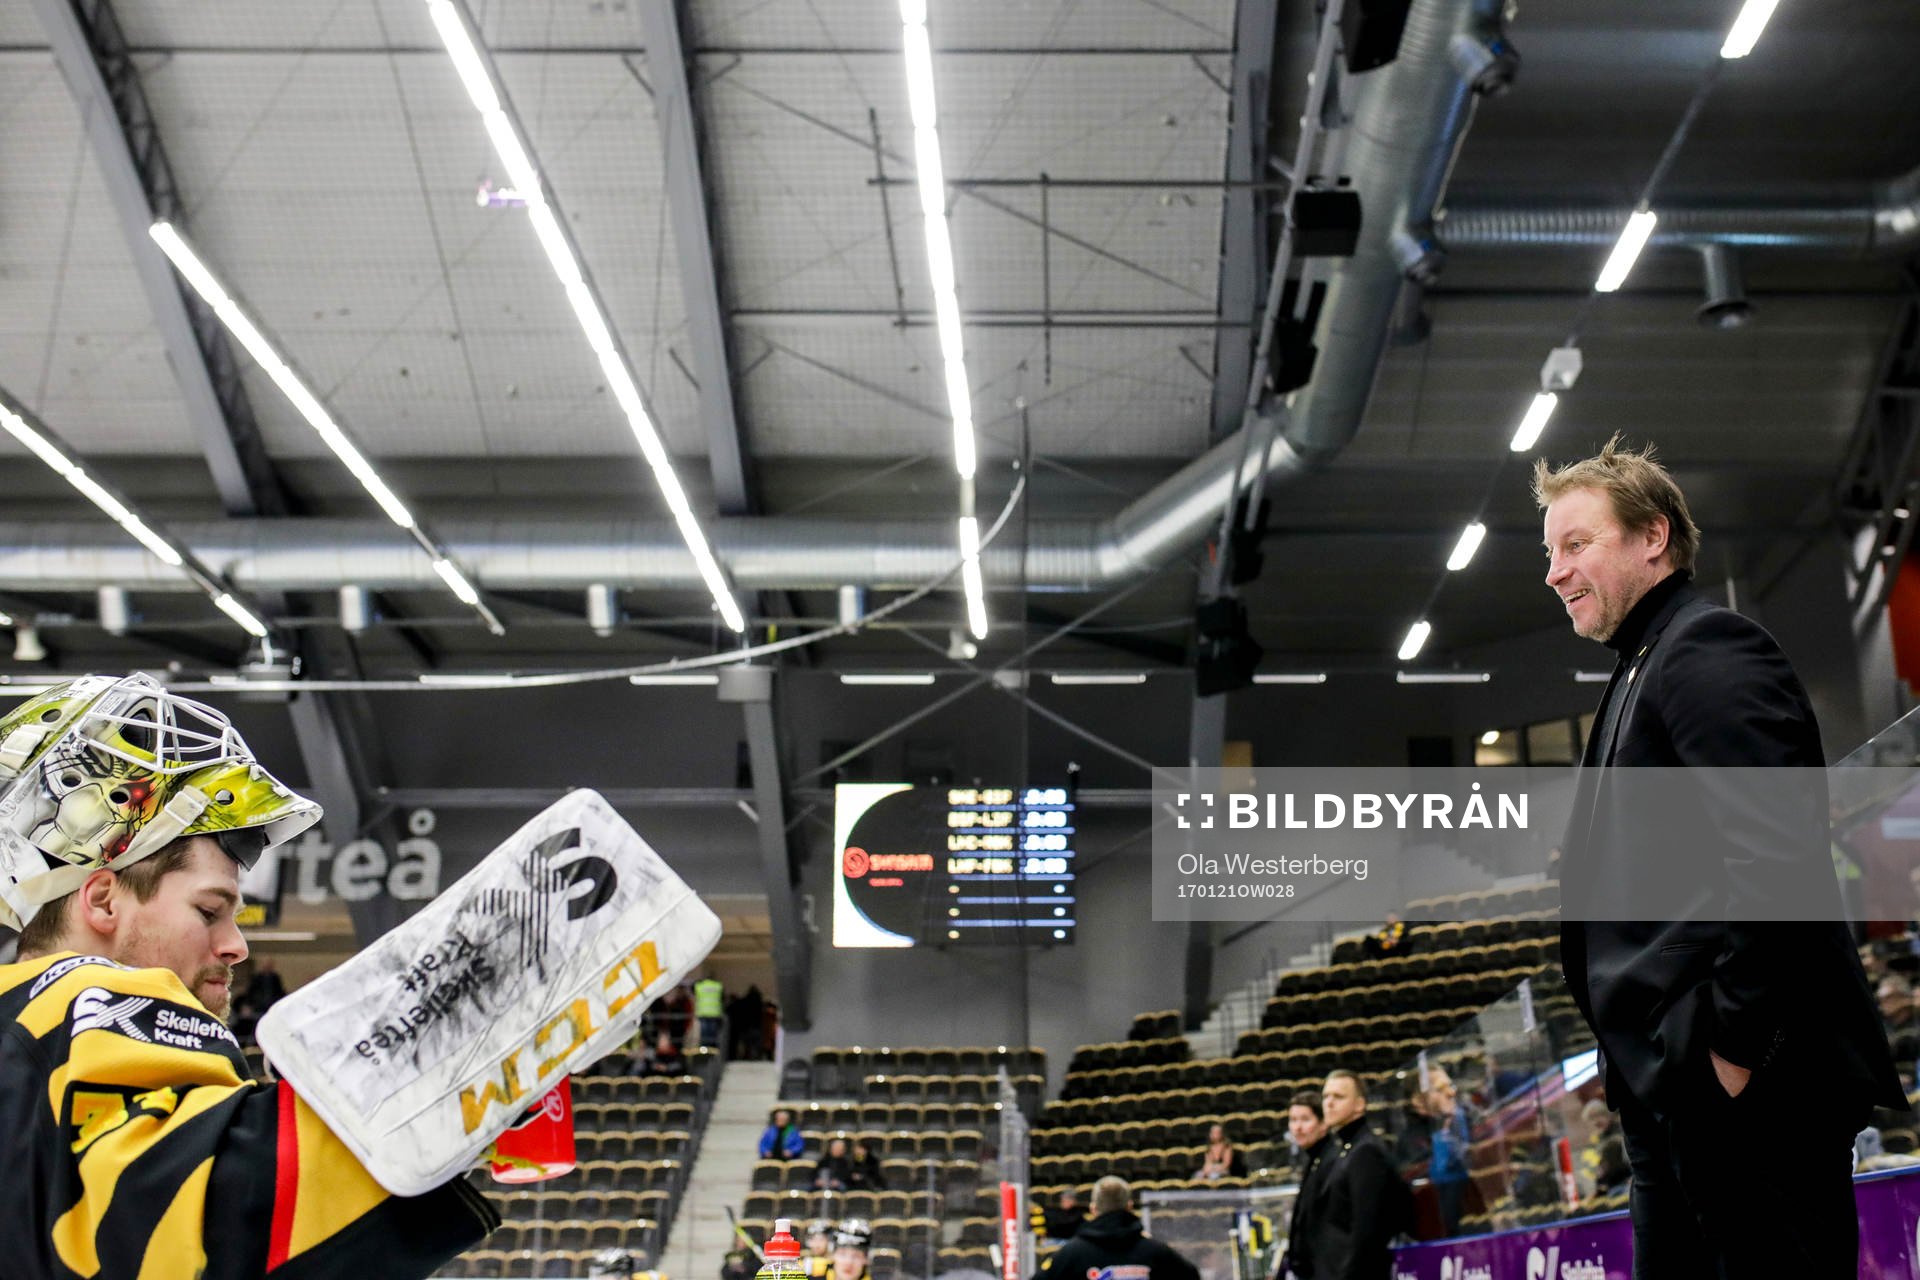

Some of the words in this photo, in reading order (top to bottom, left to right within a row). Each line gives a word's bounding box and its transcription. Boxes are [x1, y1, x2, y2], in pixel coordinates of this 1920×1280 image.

[281, 808, 442, 904] teå
[154, 1028, 203, 1049] Kraft
[459, 940, 668, 1136] CCM
